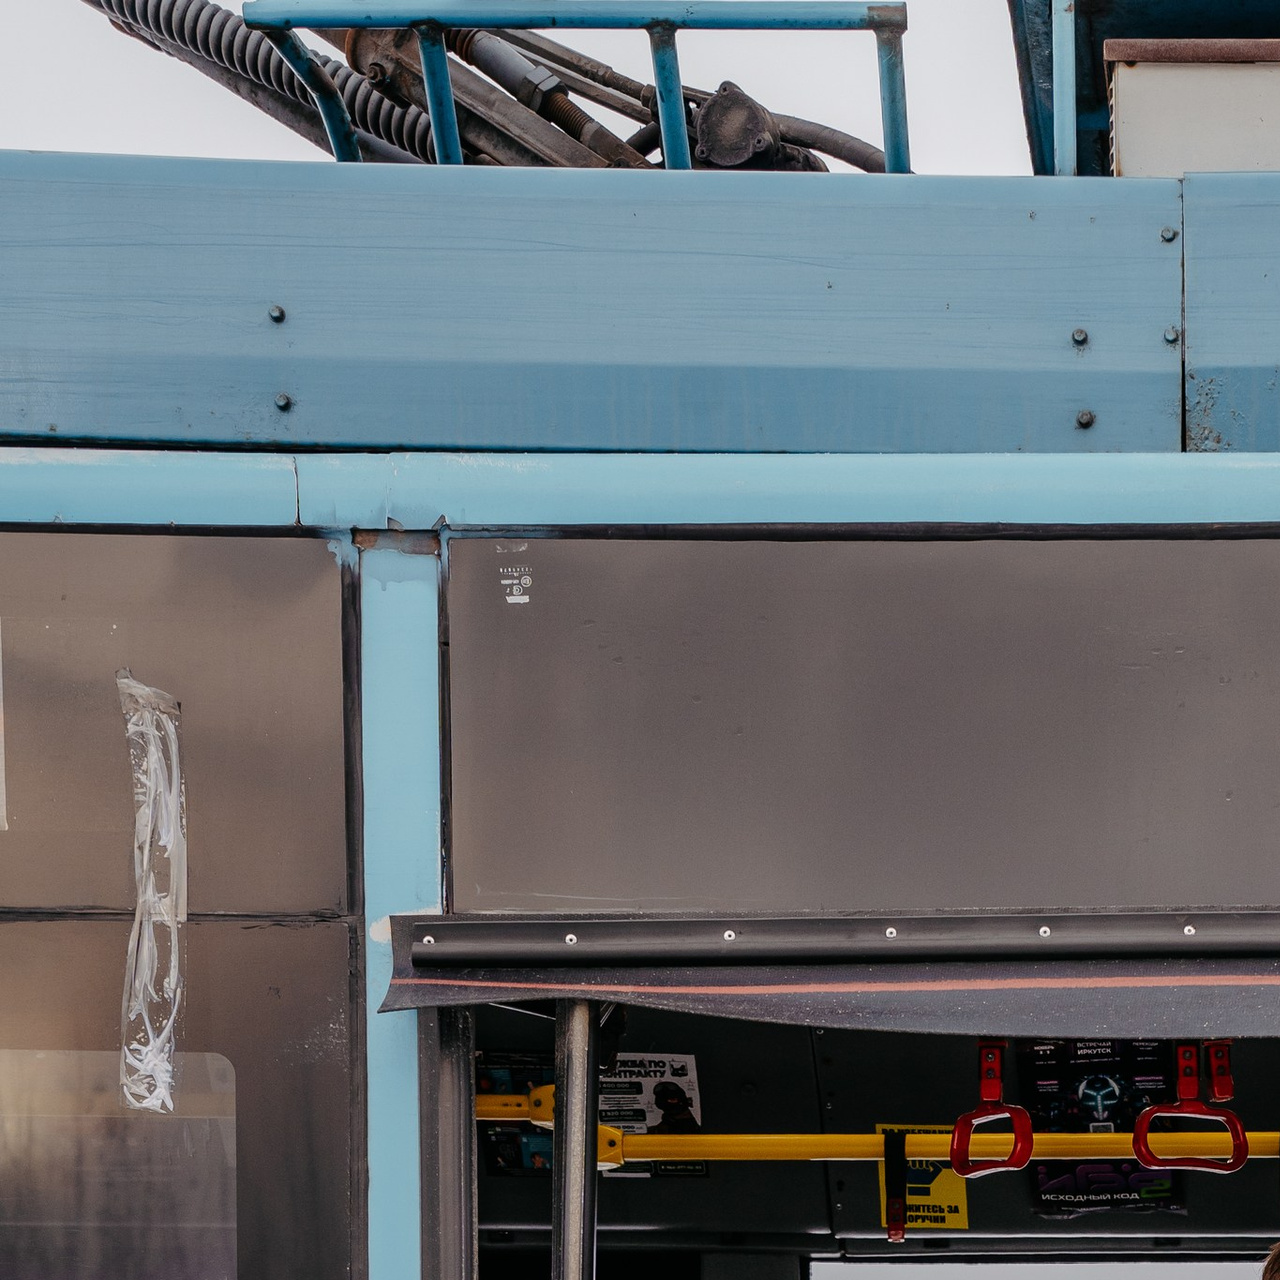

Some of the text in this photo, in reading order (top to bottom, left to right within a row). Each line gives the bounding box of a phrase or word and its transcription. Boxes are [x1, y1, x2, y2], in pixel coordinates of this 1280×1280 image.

[1077, 1048, 1112, 1056] ИРКУТСК
[648, 1060, 666, 1068] ПО
[1113, 1192, 1140, 1200] КОД
[947, 1205, 959, 1214] ЗА
[908, 1214, 946, 1224] ОРУЧНИ
